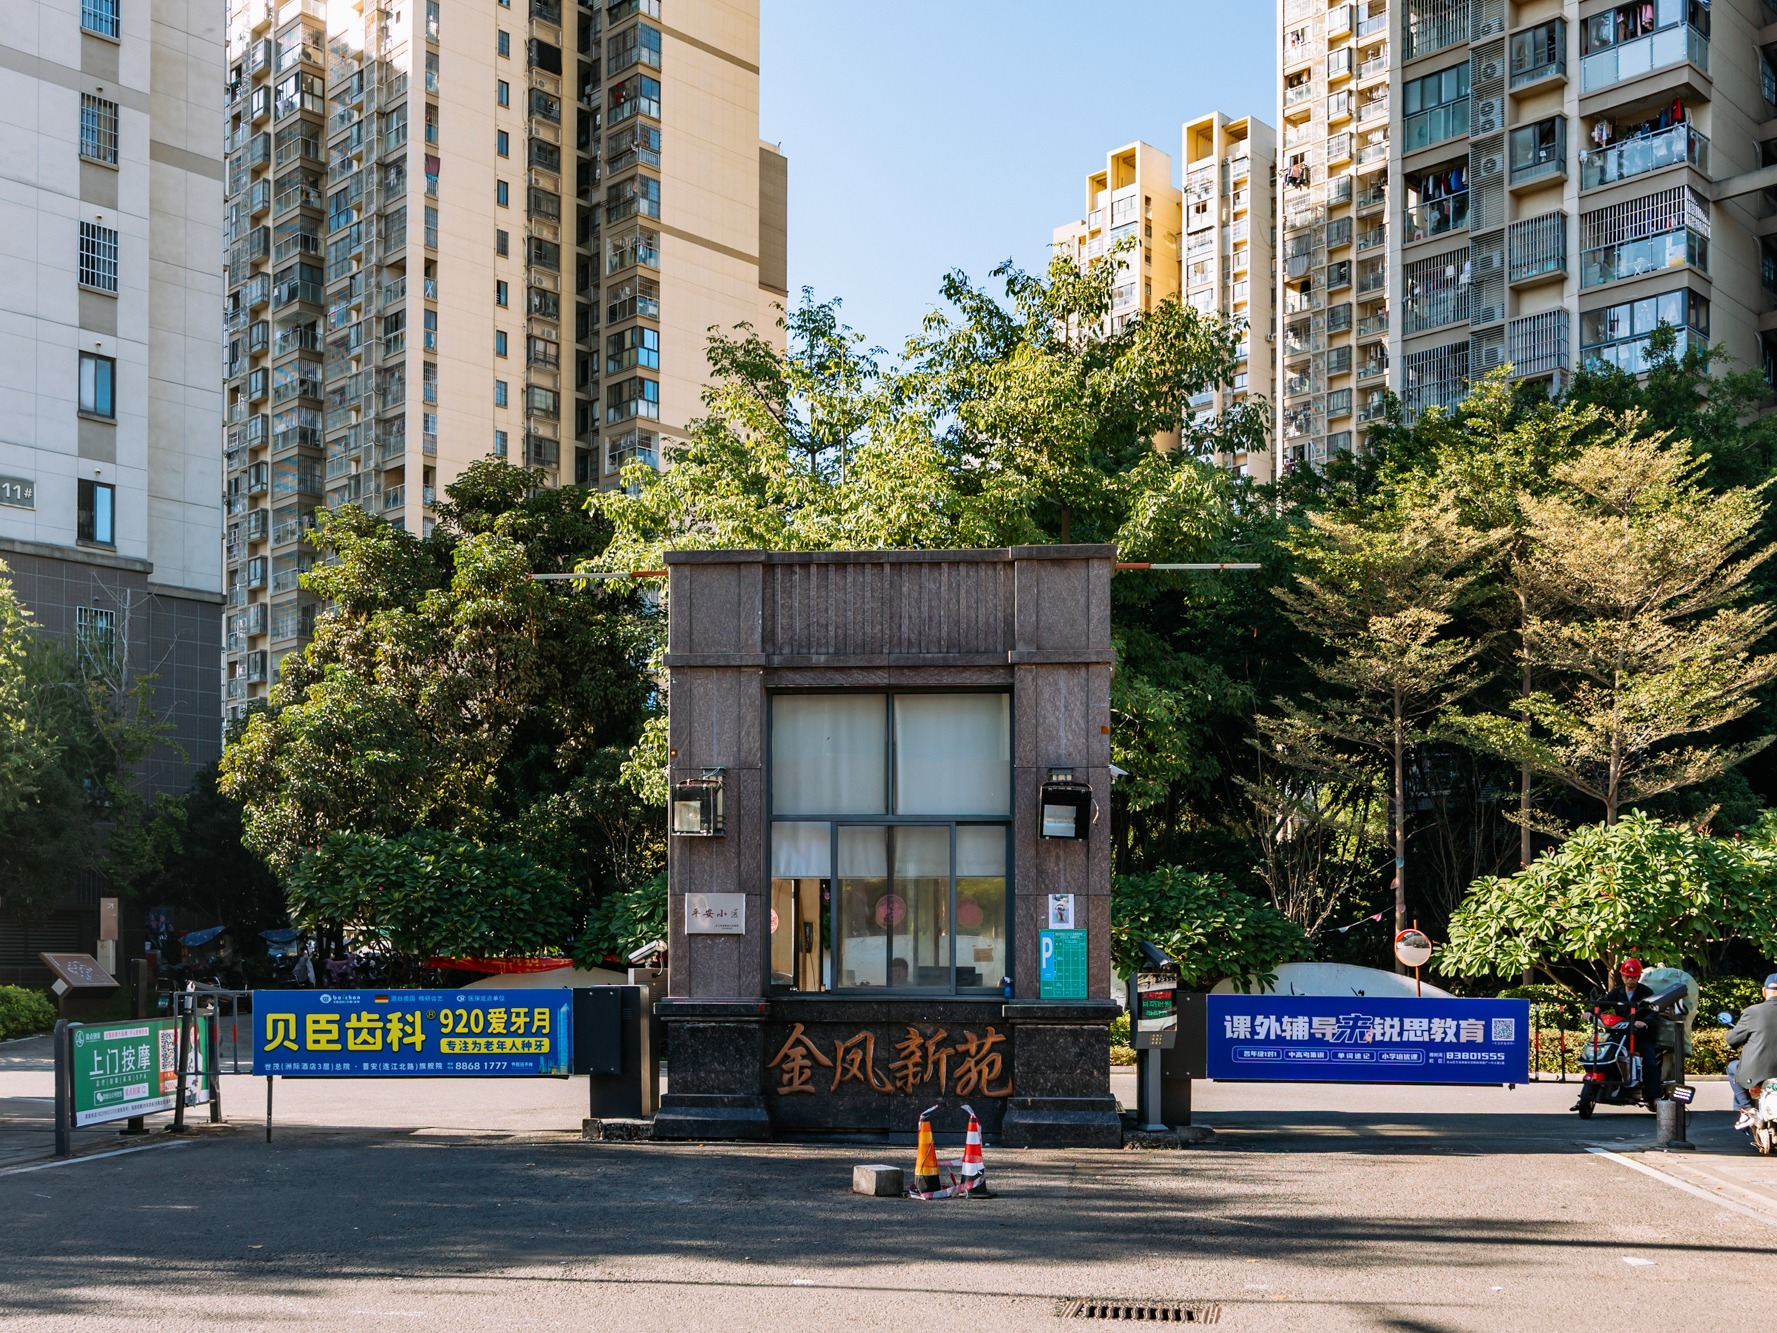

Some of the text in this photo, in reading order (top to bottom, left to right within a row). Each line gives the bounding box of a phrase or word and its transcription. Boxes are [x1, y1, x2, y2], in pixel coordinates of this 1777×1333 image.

[1, 482, 33, 501] 11#
[1042, 937, 1053, 969] P
[264, 1011, 426, 1052] 贝臣齿科
[1224, 1013, 1485, 1043] 课外辅导来锐思教育
[446, 1040, 545, 1052] 专注为老年人种牙
[89, 1043, 151, 1076] 上门按摩
[767, 1023, 1014, 1098] 金凤新苑
[1337, 1052, 1370, 1060] 单词速记
[1381, 1053, 1418, 1061] 小学培优课
[1446, 1052, 1505, 1061] 83801555
[455, 1062, 480, 1071] 8868
[484, 1062, 508, 1070] 1777
